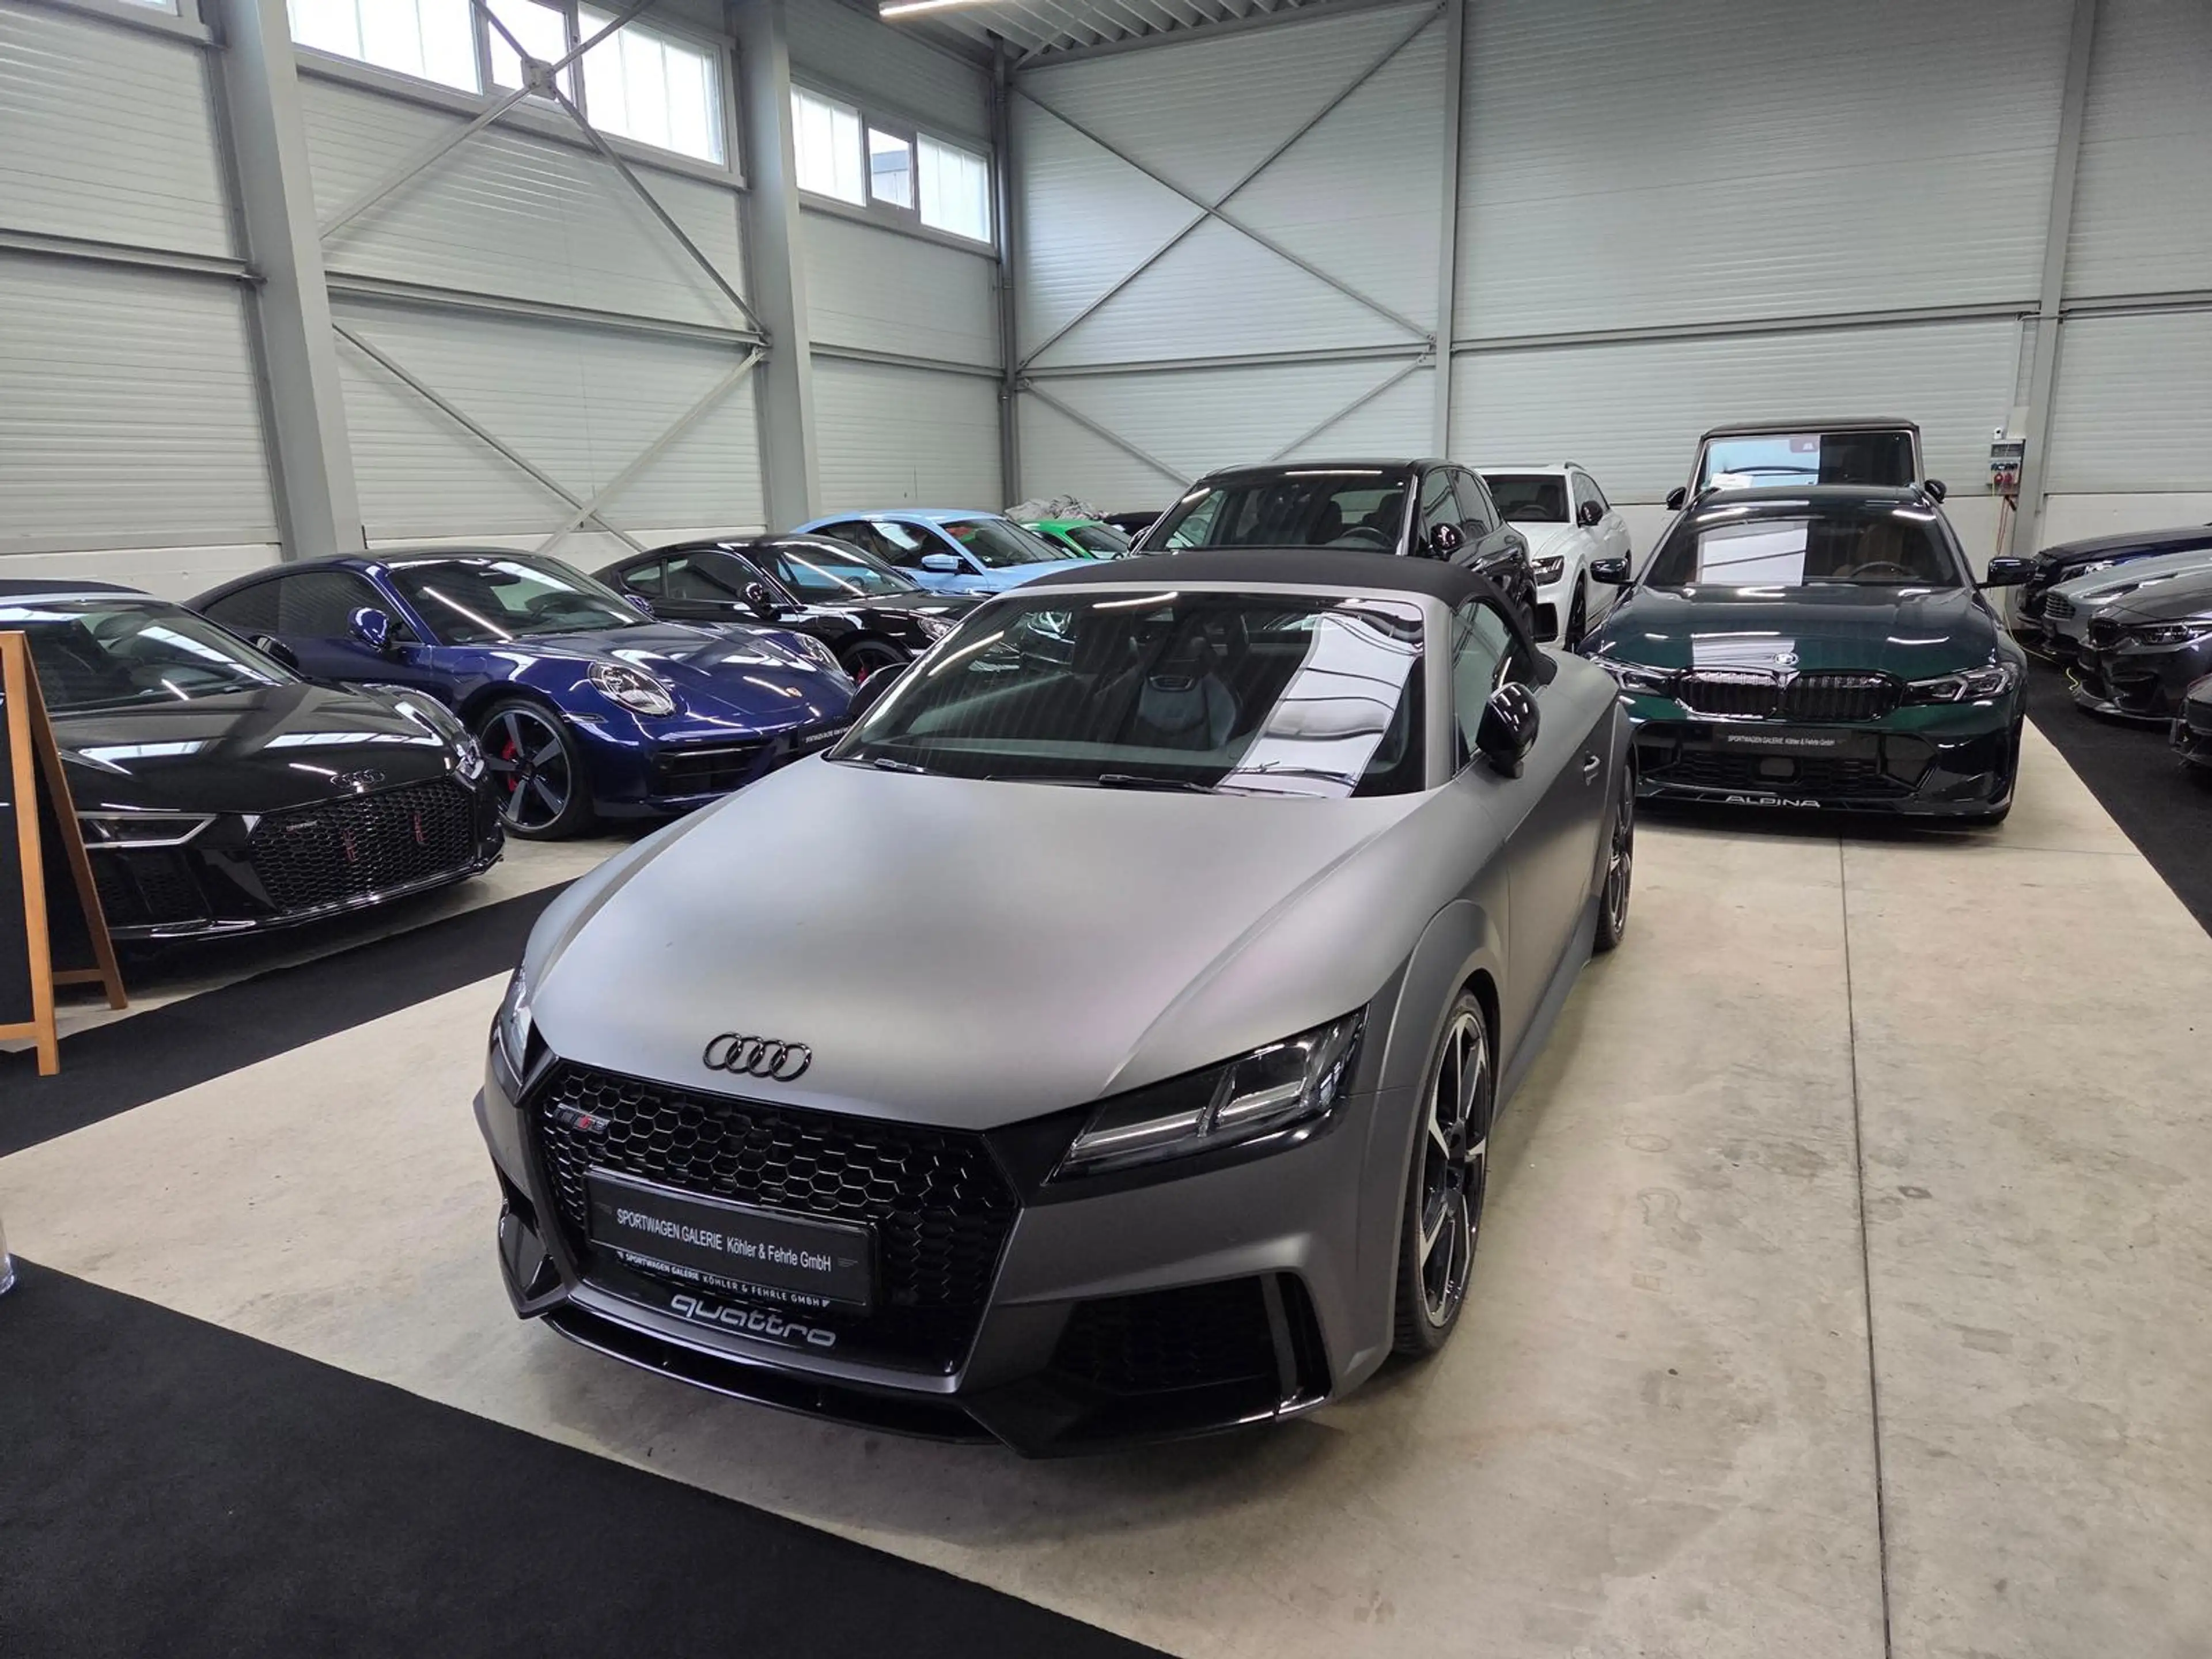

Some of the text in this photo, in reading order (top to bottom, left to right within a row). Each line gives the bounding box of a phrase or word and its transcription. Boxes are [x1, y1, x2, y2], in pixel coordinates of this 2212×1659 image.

[1725, 794, 1821, 809] ALPINA
[616, 1208, 831, 1272] SPORTWAGEN GALERIE Köhler & Fehrle GmbH
[702, 1274, 738, 1291] KÖHLER
[741, 1284, 748, 1293] &
[751, 1286, 787, 1301] FEHRLE
[790, 1294, 820, 1306] GMBH
[671, 1294, 836, 1347] quattro
